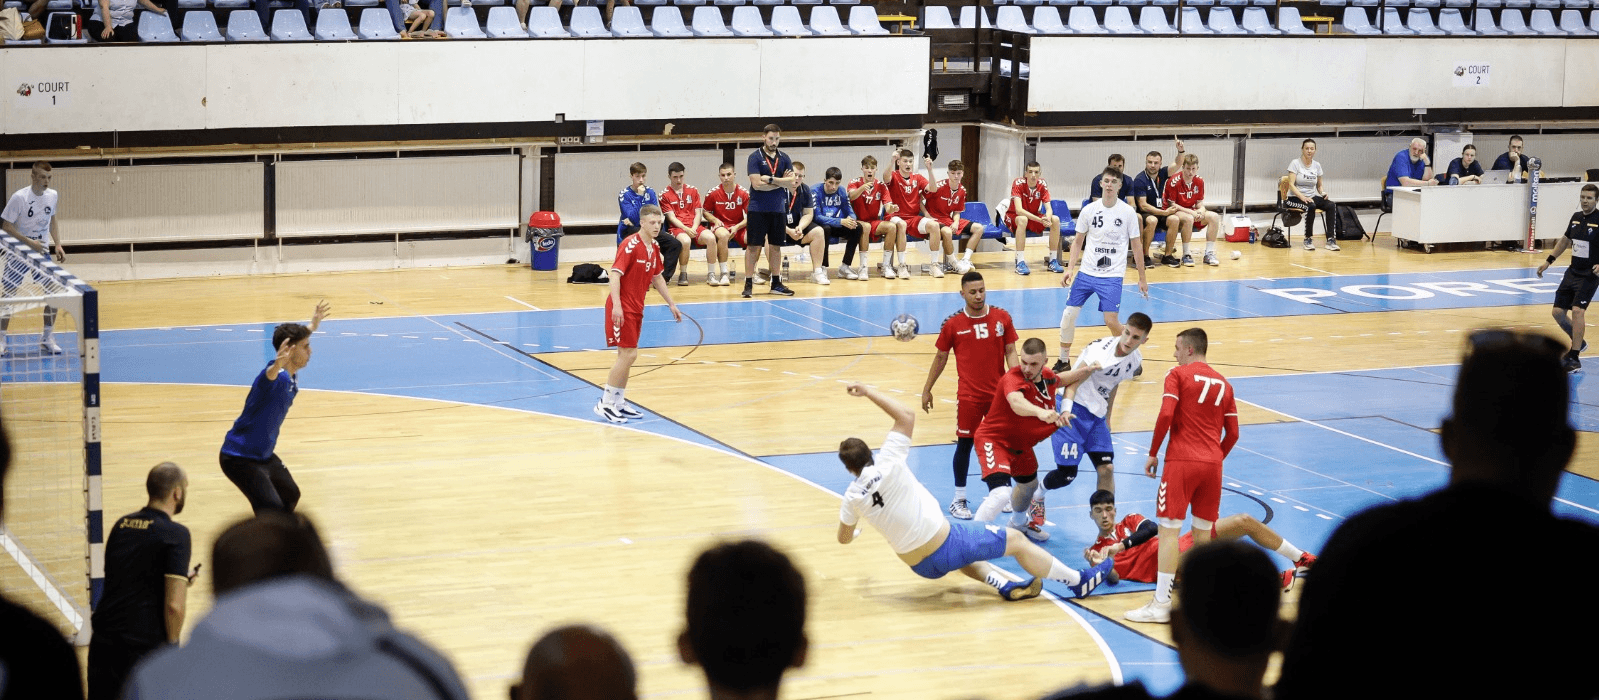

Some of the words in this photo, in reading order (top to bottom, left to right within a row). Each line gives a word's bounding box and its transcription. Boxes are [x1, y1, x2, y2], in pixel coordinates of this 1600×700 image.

[1468, 65, 1490, 74] COURT
[1476, 75, 1481, 85] 2
[38, 82, 69, 92] COURT
[52, 95, 56, 105] 1
[1532, 170, 1540, 203] molten
[27, 206, 34, 217] 6
[725, 201, 736, 210] 20
[1092, 216, 1104, 228] 45
[1259, 274, 1565, 304] PORE
[973, 323, 989, 339] 15
[1194, 375, 1225, 406] 77
[1060, 442, 1079, 459] 44
[872, 491, 885, 508] 4
